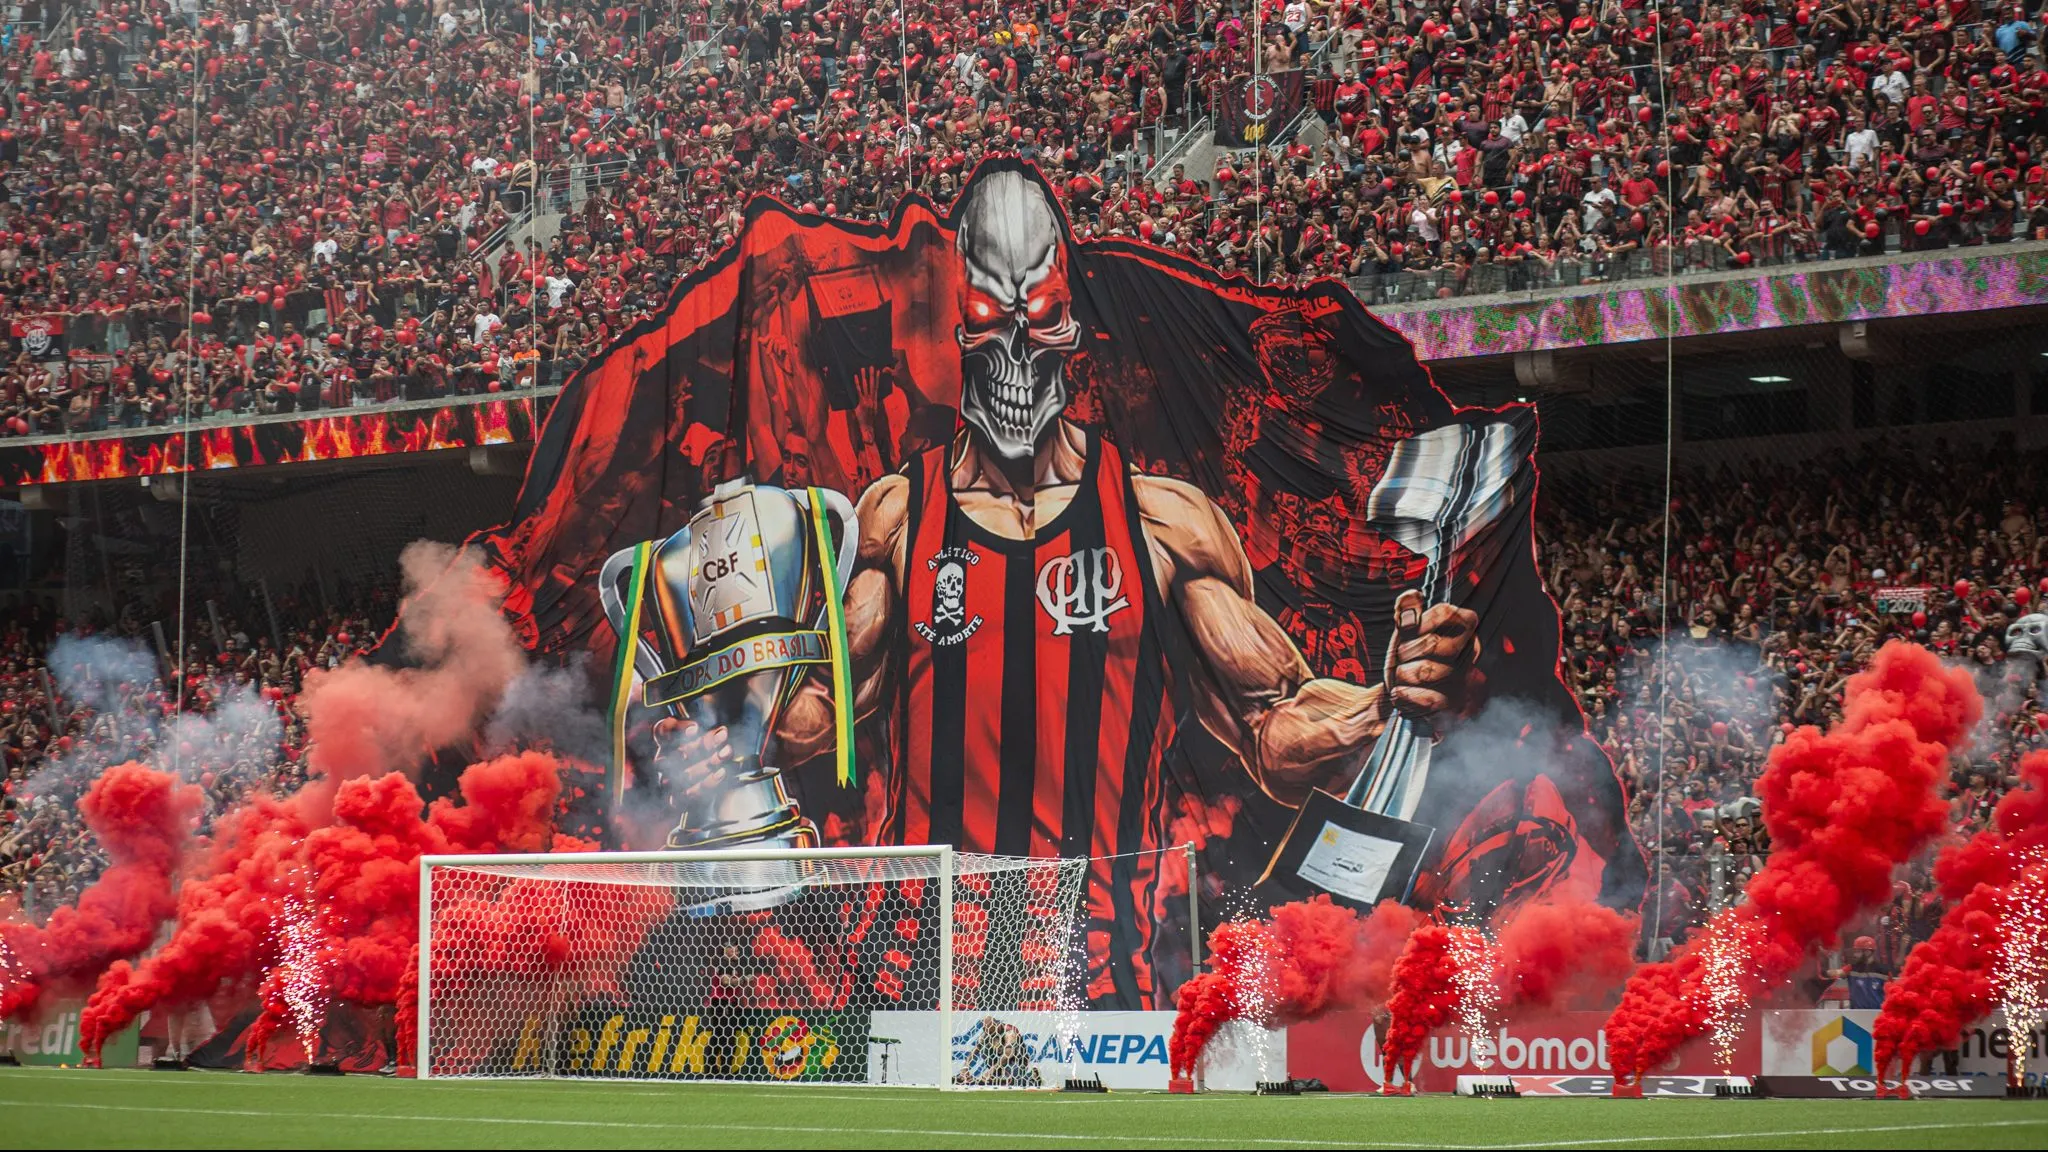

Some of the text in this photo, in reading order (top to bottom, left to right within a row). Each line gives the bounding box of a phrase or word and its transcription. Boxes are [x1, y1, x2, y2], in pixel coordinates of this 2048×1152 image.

[702, 551, 740, 583] CBF
[717, 646, 746, 676] DO
[752, 634, 815, 663] BRASIL
[1022, 1033, 1174, 1065] SANEPA
[1429, 1028, 1681, 1071] webmot
